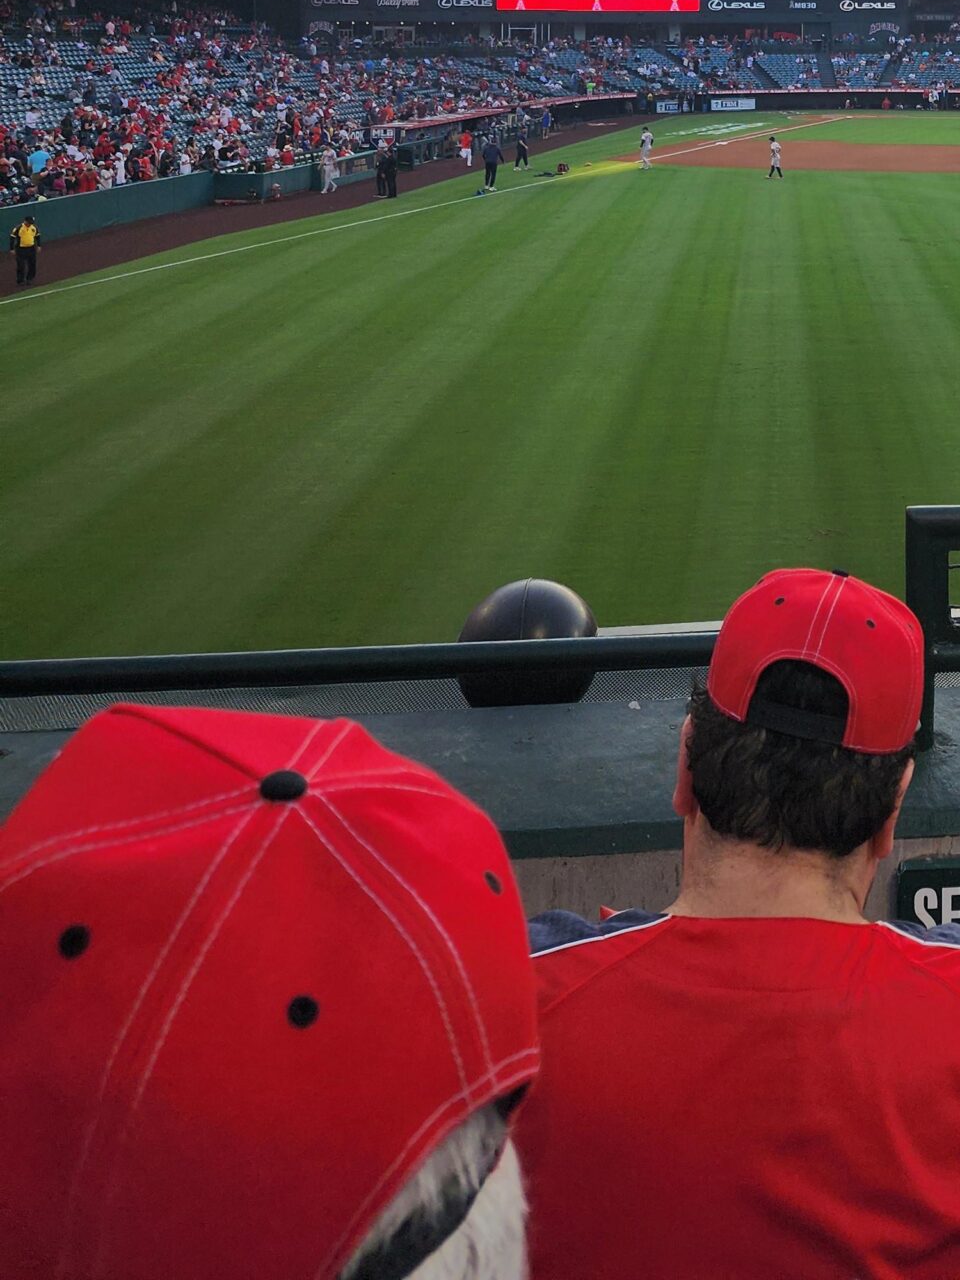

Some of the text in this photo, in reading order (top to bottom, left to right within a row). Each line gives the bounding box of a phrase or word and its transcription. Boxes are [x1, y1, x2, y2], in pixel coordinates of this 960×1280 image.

[452, 0, 493, 7] LEXUS
[723, 0, 766, 9] LEXUS
[855, 1, 896, 9] LEXUS
